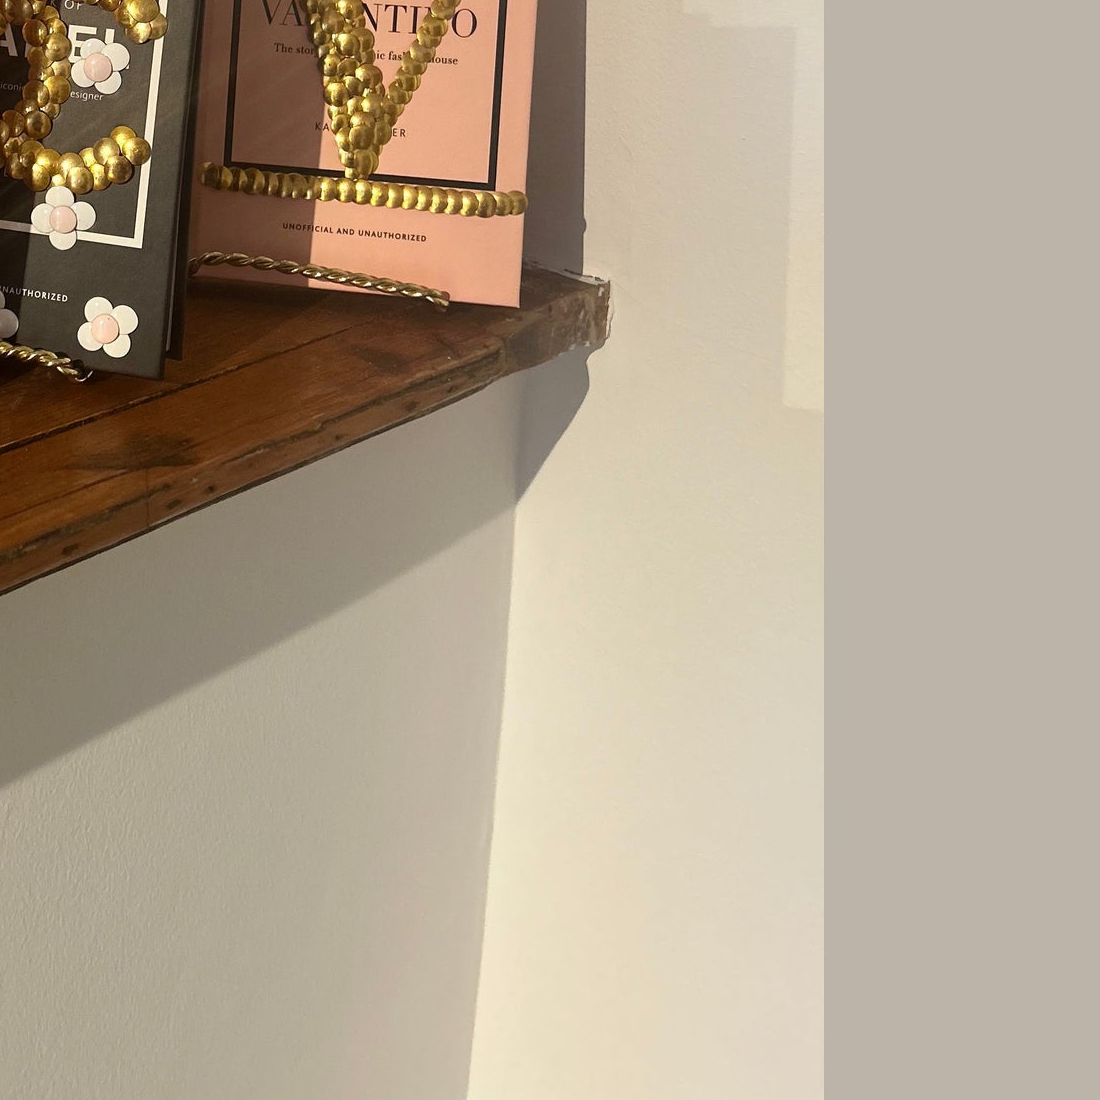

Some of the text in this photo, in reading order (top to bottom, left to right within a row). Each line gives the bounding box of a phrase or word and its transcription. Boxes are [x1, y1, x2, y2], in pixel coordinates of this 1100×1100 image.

[274, 42, 293, 54] The
[0, 82, 24, 92] iconi
[70, 90, 104, 102] esigner
[282, 222, 427, 242] UNOFFICIAL AND UNAUTHORIZED
